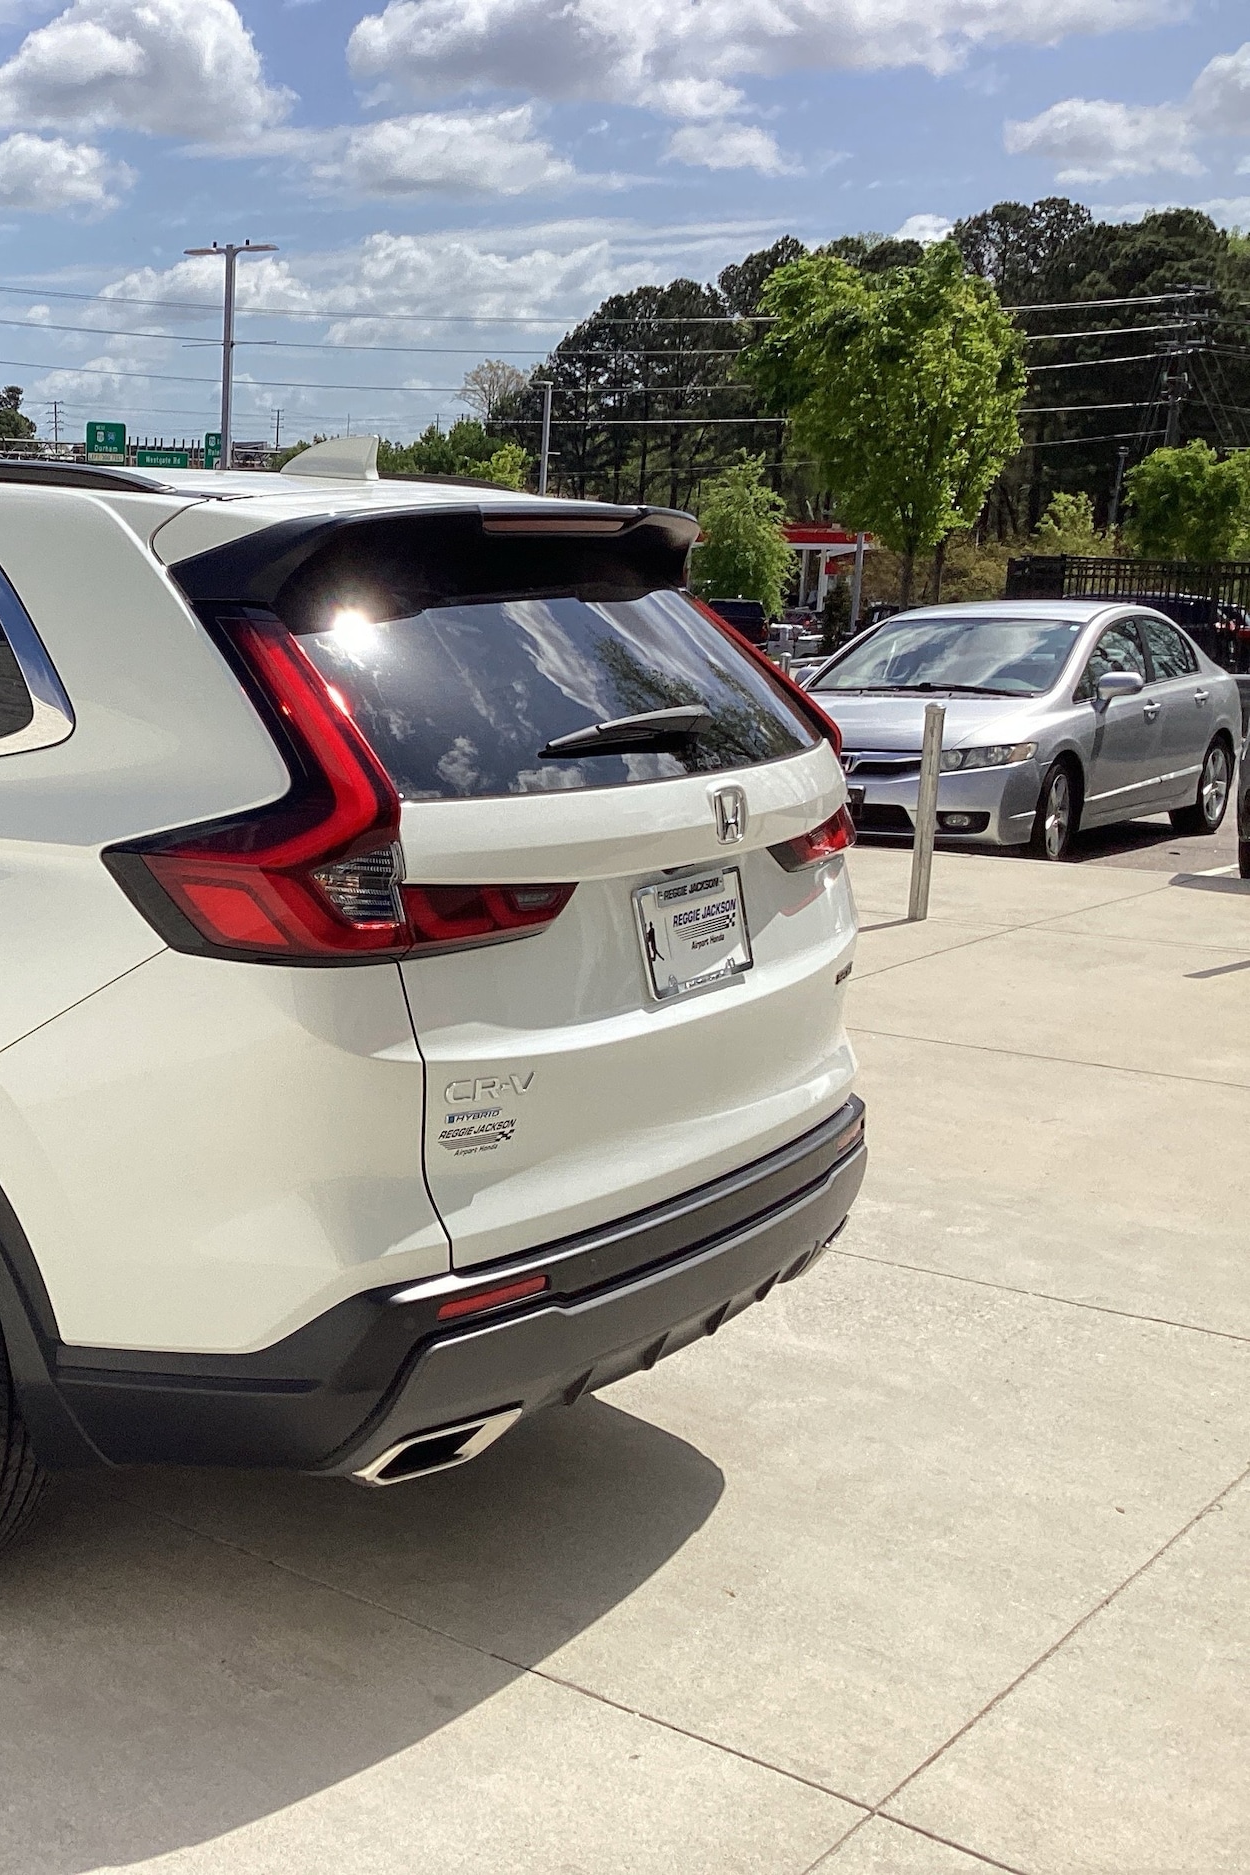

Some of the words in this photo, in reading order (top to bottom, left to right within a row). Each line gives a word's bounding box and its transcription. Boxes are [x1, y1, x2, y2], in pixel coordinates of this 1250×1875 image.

[94, 444, 118, 452] Durham
[145, 456, 171, 465] Westgate
[663, 885, 688, 900] REGGIE
[688, 877, 720, 894] JACKSON
[673, 909, 700, 927] REGGIE
[701, 899, 737, 919] JACKSON
[691, 938, 709, 950] Airport
[710, 934, 725, 945] Honda
[444, 1071, 536, 1105] CR-V
[456, 1109, 500, 1122] HYBRID
[438, 1126, 474, 1140] REGGIE
[473, 1119, 517, 1134] JACKSON
[454, 1146, 478, 1157] Airport
[479, 1143, 498, 1152] Honda
